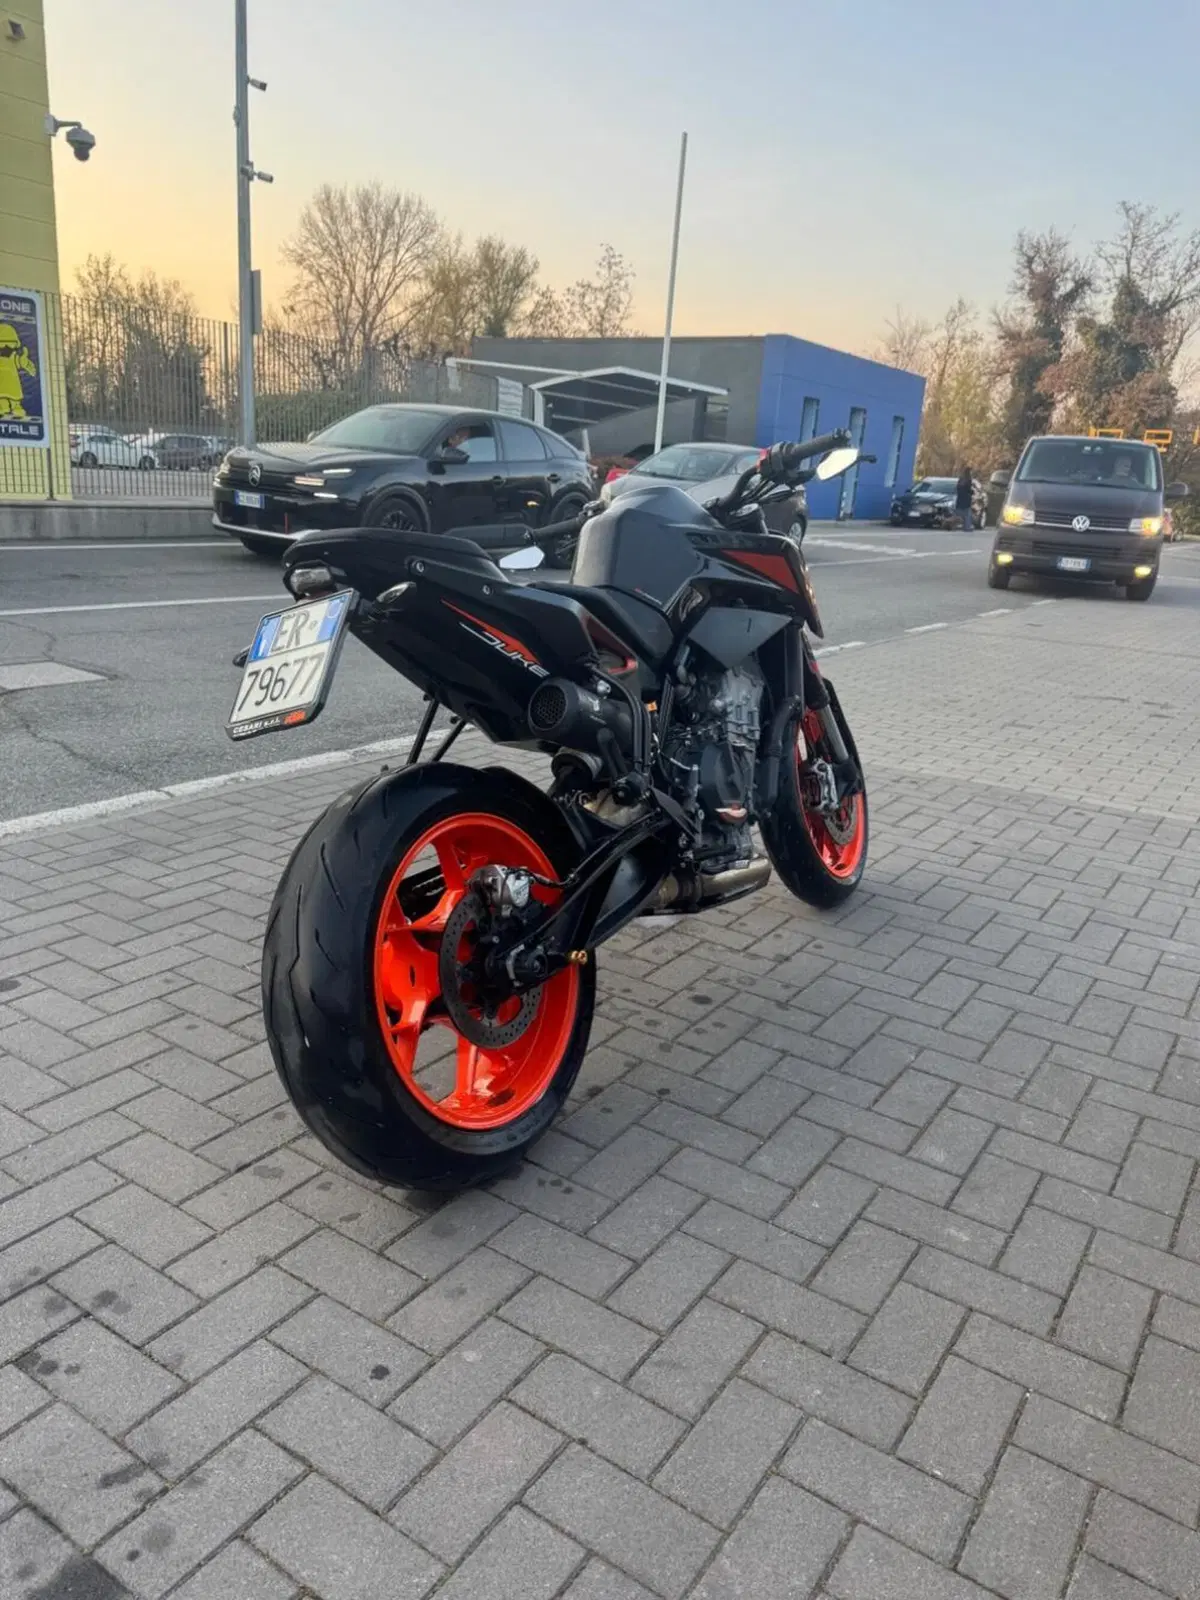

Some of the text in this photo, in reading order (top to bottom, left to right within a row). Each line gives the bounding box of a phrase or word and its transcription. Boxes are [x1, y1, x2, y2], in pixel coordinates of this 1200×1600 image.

[271, 610, 310, 651] ER
[458, 621, 550, 678] DUKE
[237, 651, 325, 712] 79677
